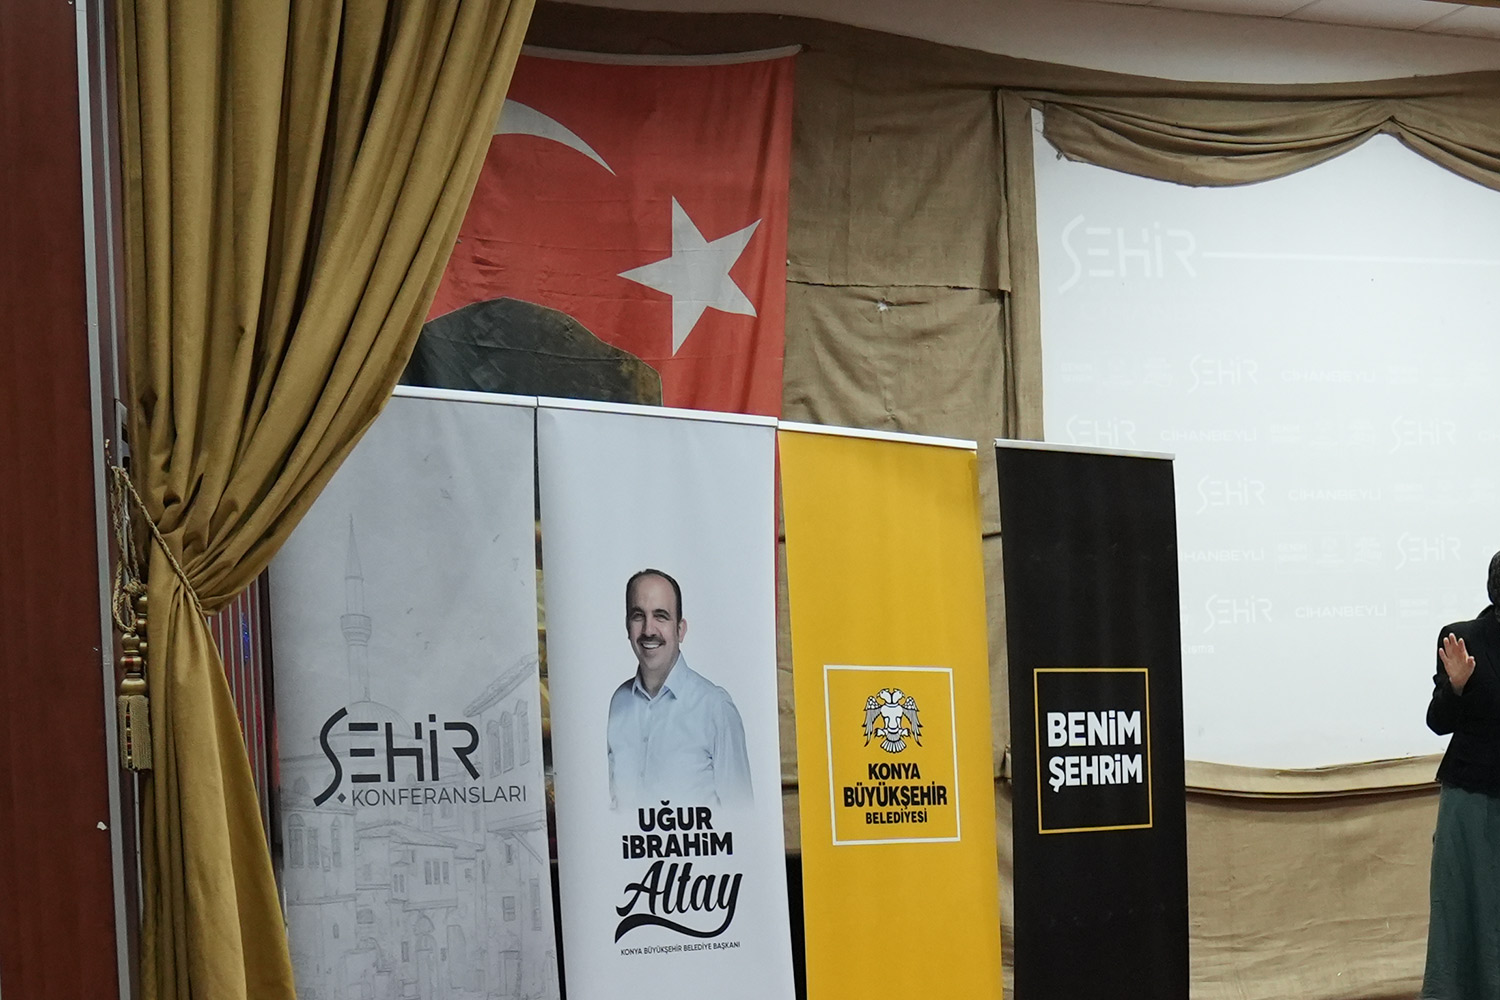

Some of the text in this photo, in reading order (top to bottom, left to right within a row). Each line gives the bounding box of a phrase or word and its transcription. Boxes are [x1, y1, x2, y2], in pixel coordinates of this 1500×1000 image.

[867, 762, 921, 781] KONYA
[351, 785, 527, 807] KONFERANSLARI
[843, 780, 948, 809] BÜYÜKŞEHİR
[638, 799, 713, 832] UĞUR
[865, 809, 928, 825] BELEDİYESİ
[614, 860, 743, 943] Altay
[620, 941, 741, 956] KONYA BÜYÜKŞEHİR BELEDİYE BAŞKANI
